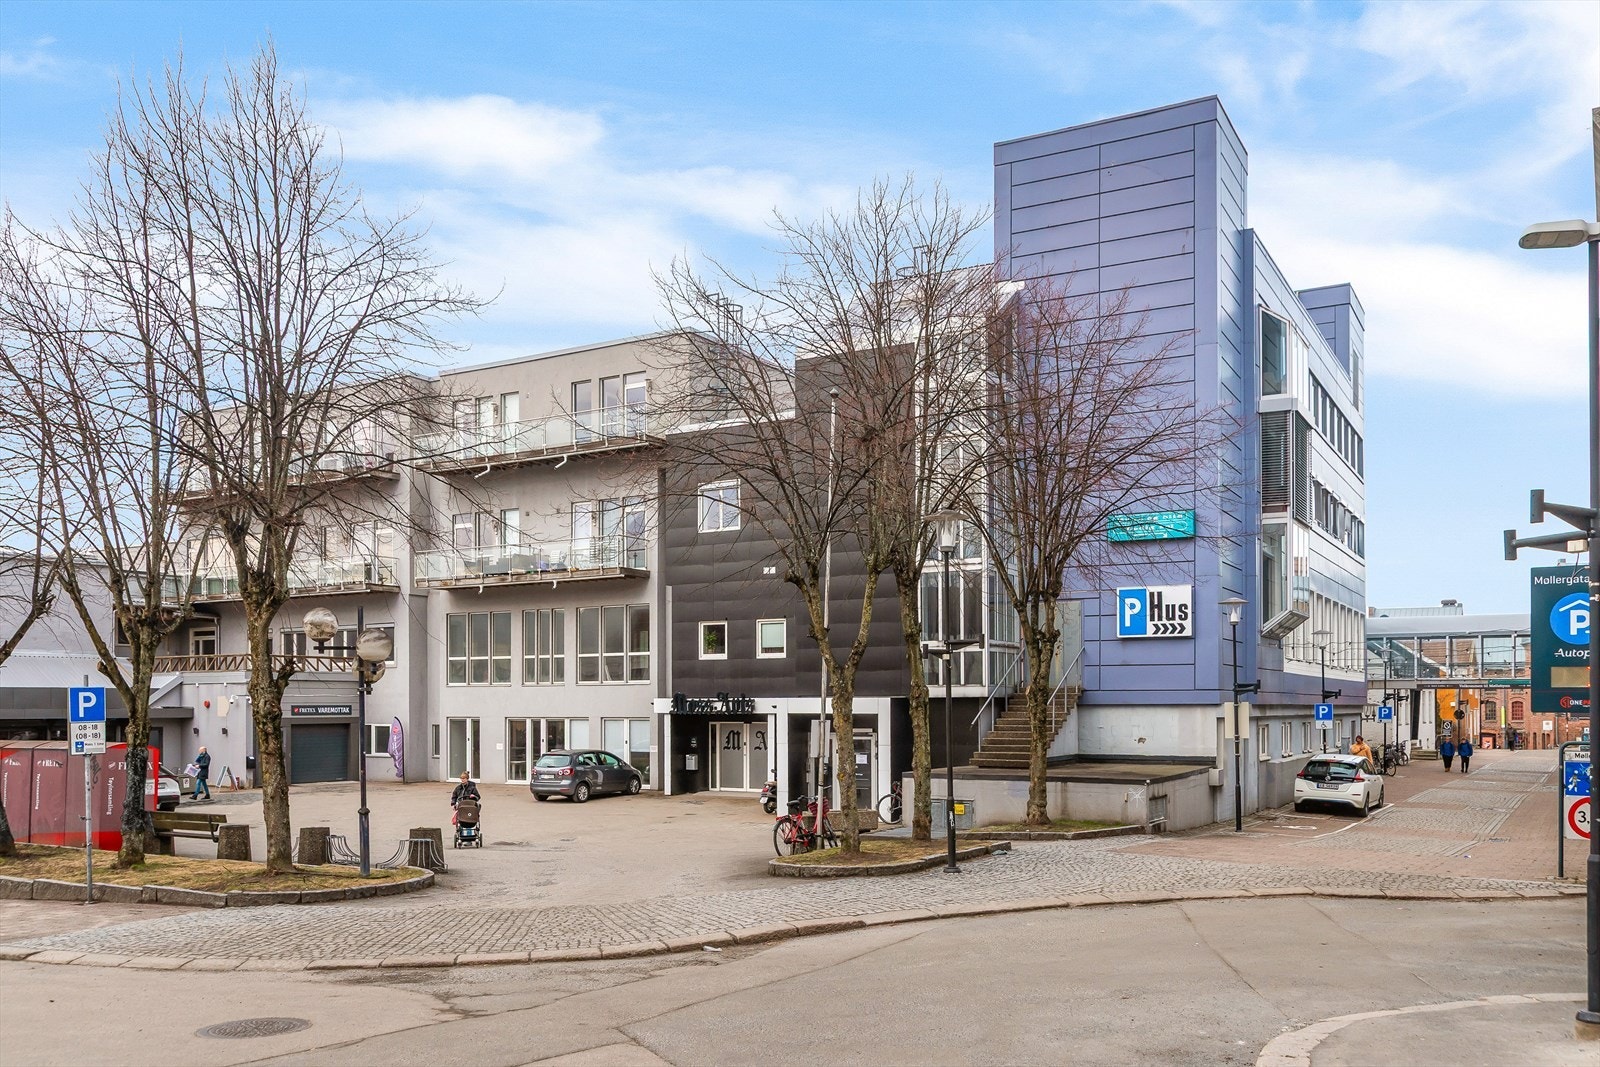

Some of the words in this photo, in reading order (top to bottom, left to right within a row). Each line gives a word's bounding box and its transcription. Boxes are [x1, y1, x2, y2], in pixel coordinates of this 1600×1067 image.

[1534, 575, 1590, 585] Møllergata
[1124, 597, 1142, 627] P
[1149, 591, 1188, 622] Hus
[1557, 648, 1590, 659] Autop
[78, 691, 97, 718] P
[1319, 705, 1329, 718] P
[1381, 708, 1389, 718] P
[723, 729, 742, 750] M
